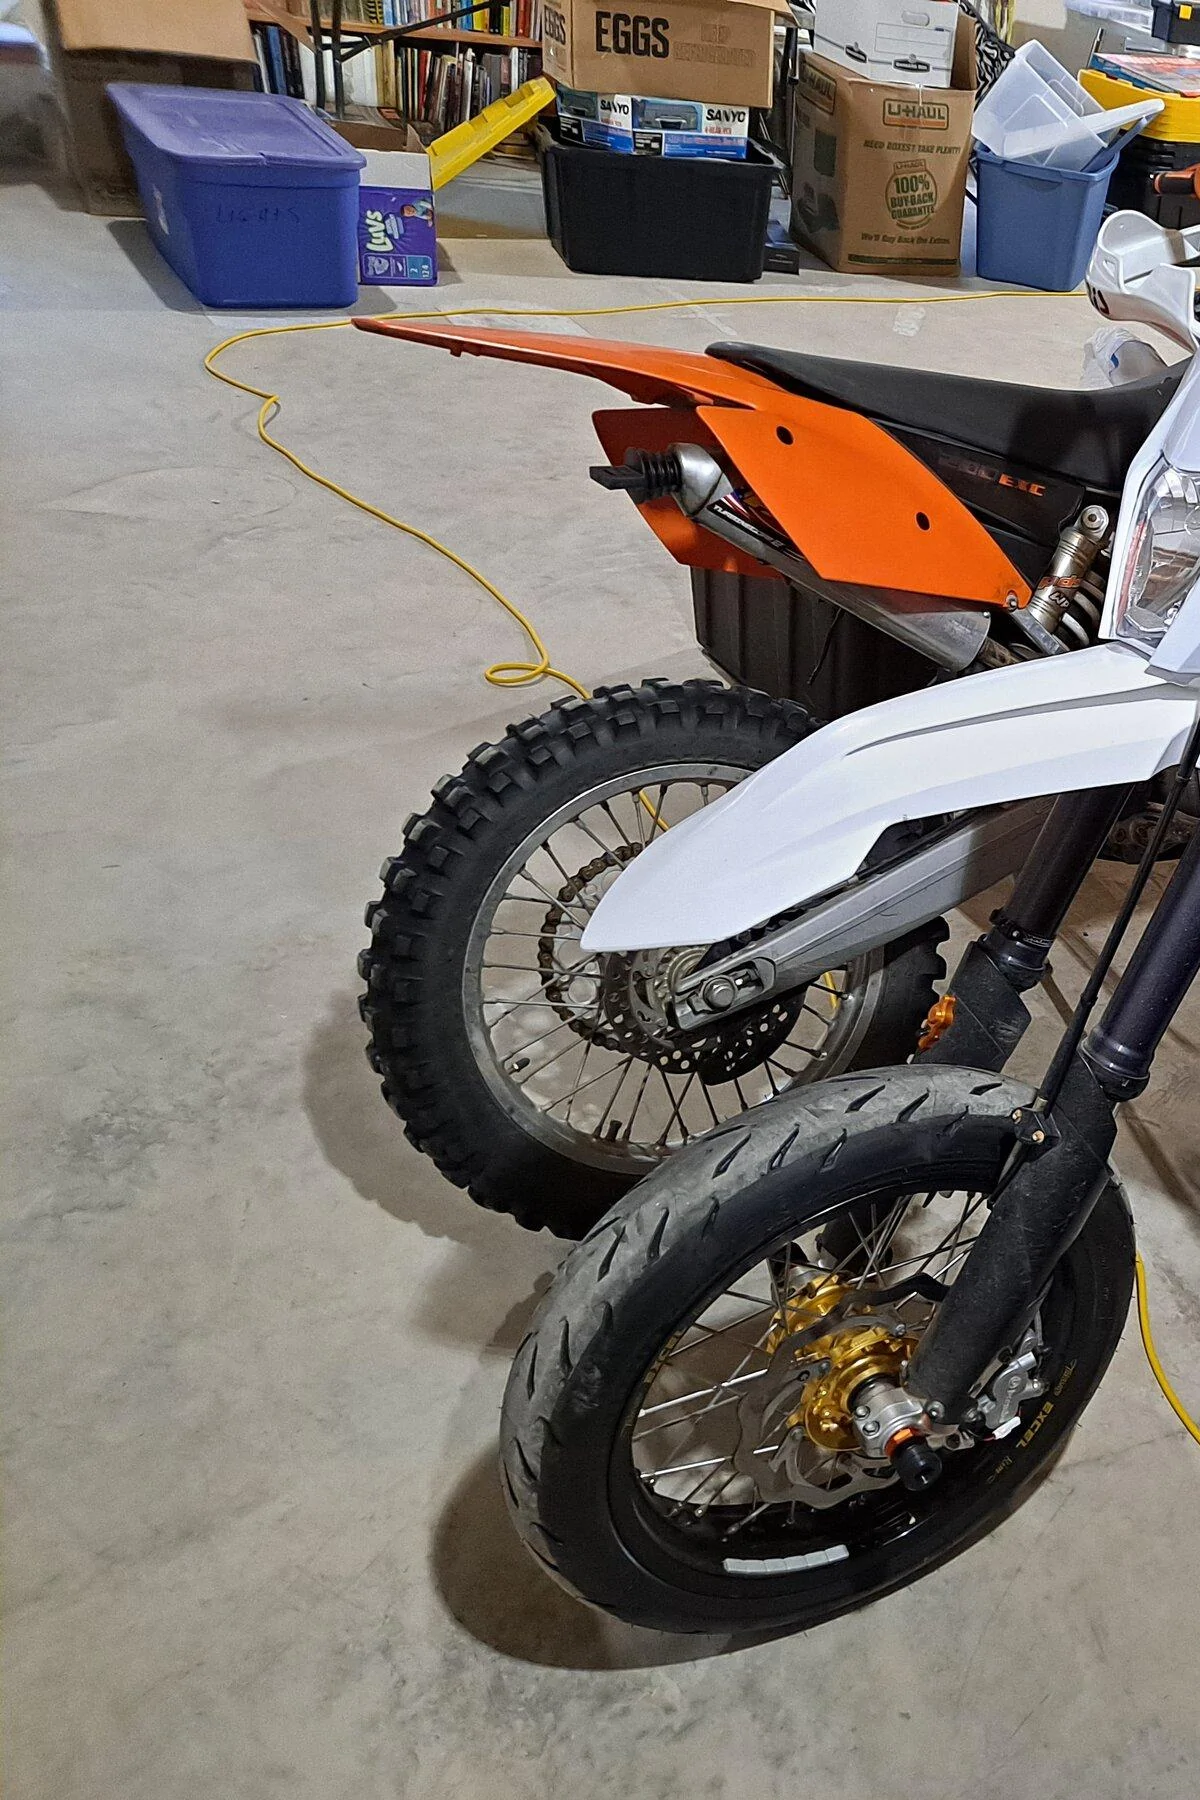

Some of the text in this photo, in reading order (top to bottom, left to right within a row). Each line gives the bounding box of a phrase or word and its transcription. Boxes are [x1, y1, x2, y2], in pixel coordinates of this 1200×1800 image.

[544, 5, 566, 45] EGGS
[595, 10, 670, 59] EGGS
[600, 99, 630, 115] SANYO
[706, 108, 746, 124] SANYO
[887, 102, 946, 120] U-HAUL
[893, 173, 931, 195] 100%
[1016, 1401, 1055, 1448] EXCEL
